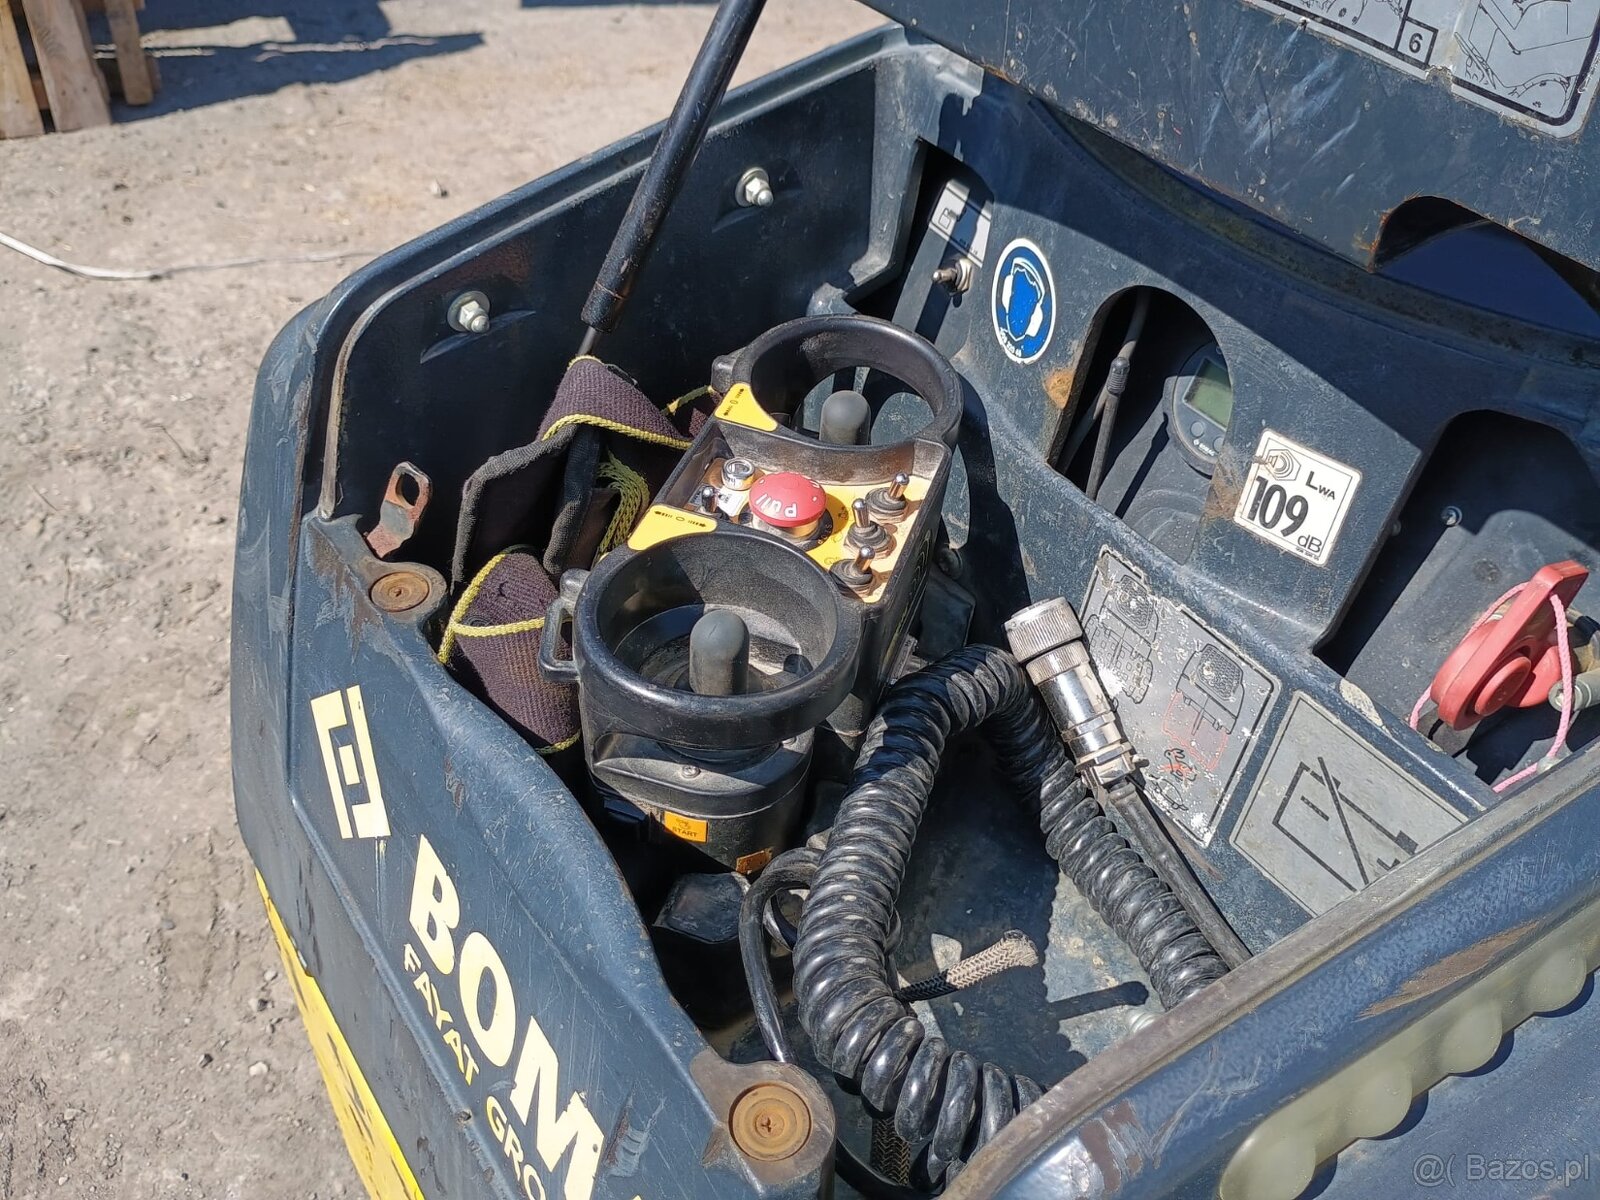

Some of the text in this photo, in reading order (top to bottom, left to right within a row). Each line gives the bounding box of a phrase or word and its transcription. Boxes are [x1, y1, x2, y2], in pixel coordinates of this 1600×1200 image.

[1408, 32, 1424, 54] 6
[1247, 476, 1309, 537] 109
[1297, 534, 1323, 553] dB
[673, 827, 698, 837] START
[403, 942, 480, 1087] FAYAT
[408, 833, 643, 1200] BOM
